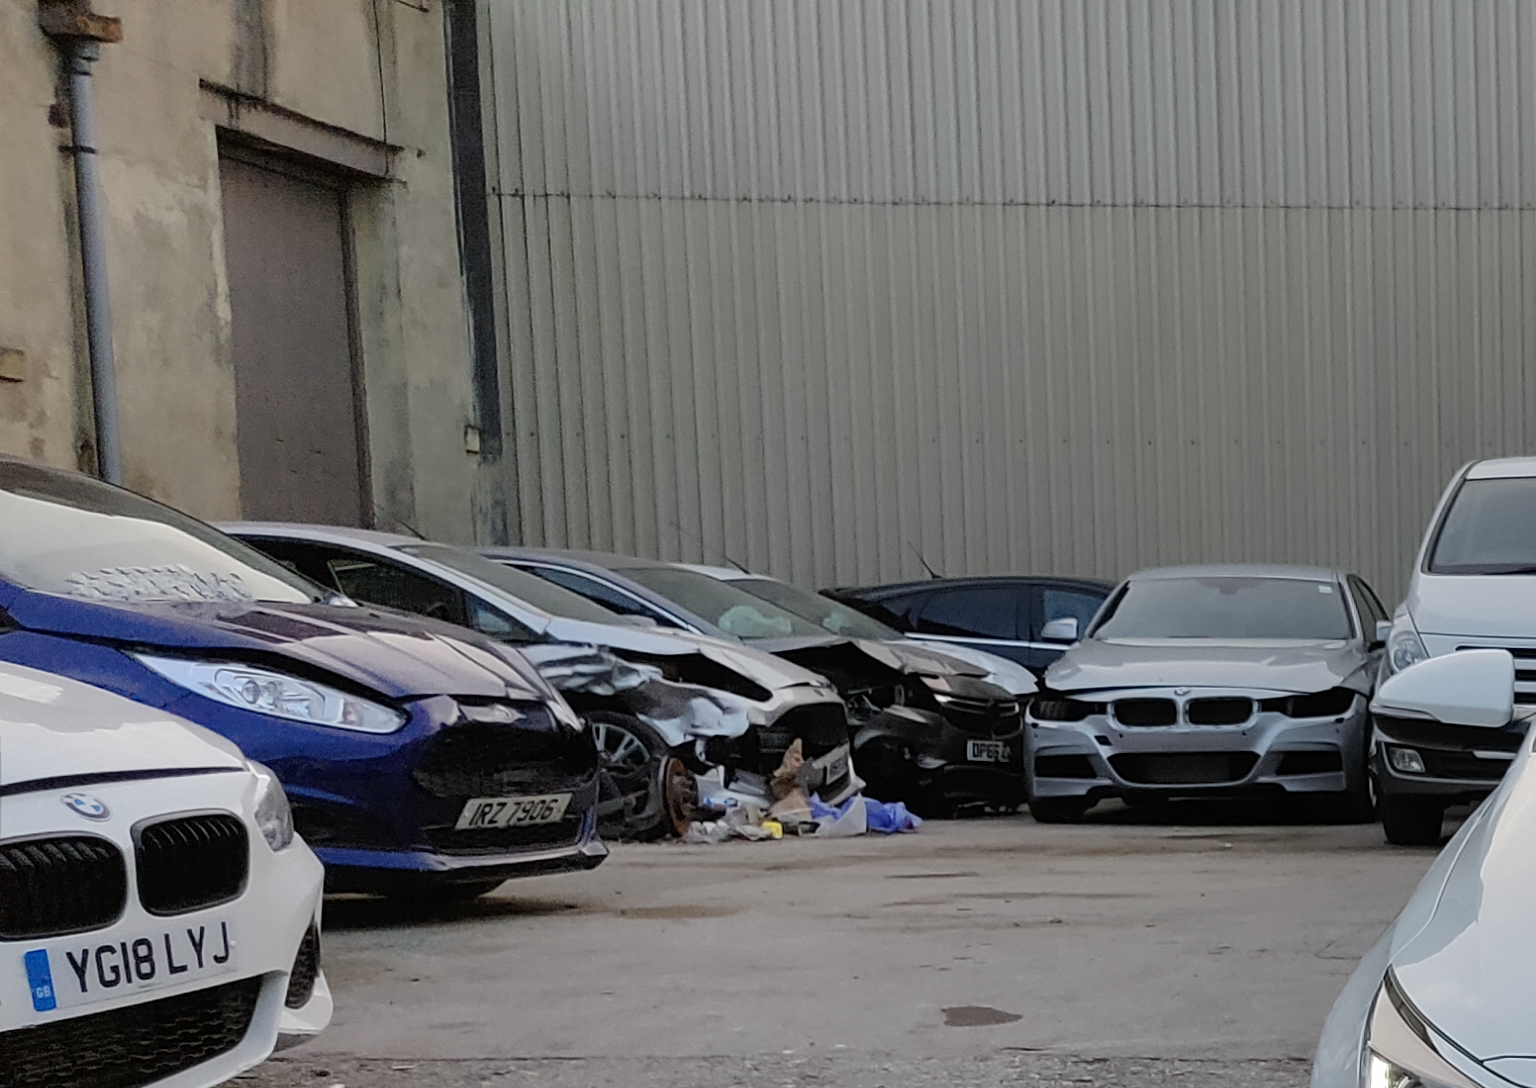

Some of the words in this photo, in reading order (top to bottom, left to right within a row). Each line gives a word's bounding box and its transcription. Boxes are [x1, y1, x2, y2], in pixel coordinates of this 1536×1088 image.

[506, 798, 560, 823] 7906
[66, 937, 156, 993] YG18
[164, 921, 230, 976] LYJ
[36, 985, 51, 998] GB
